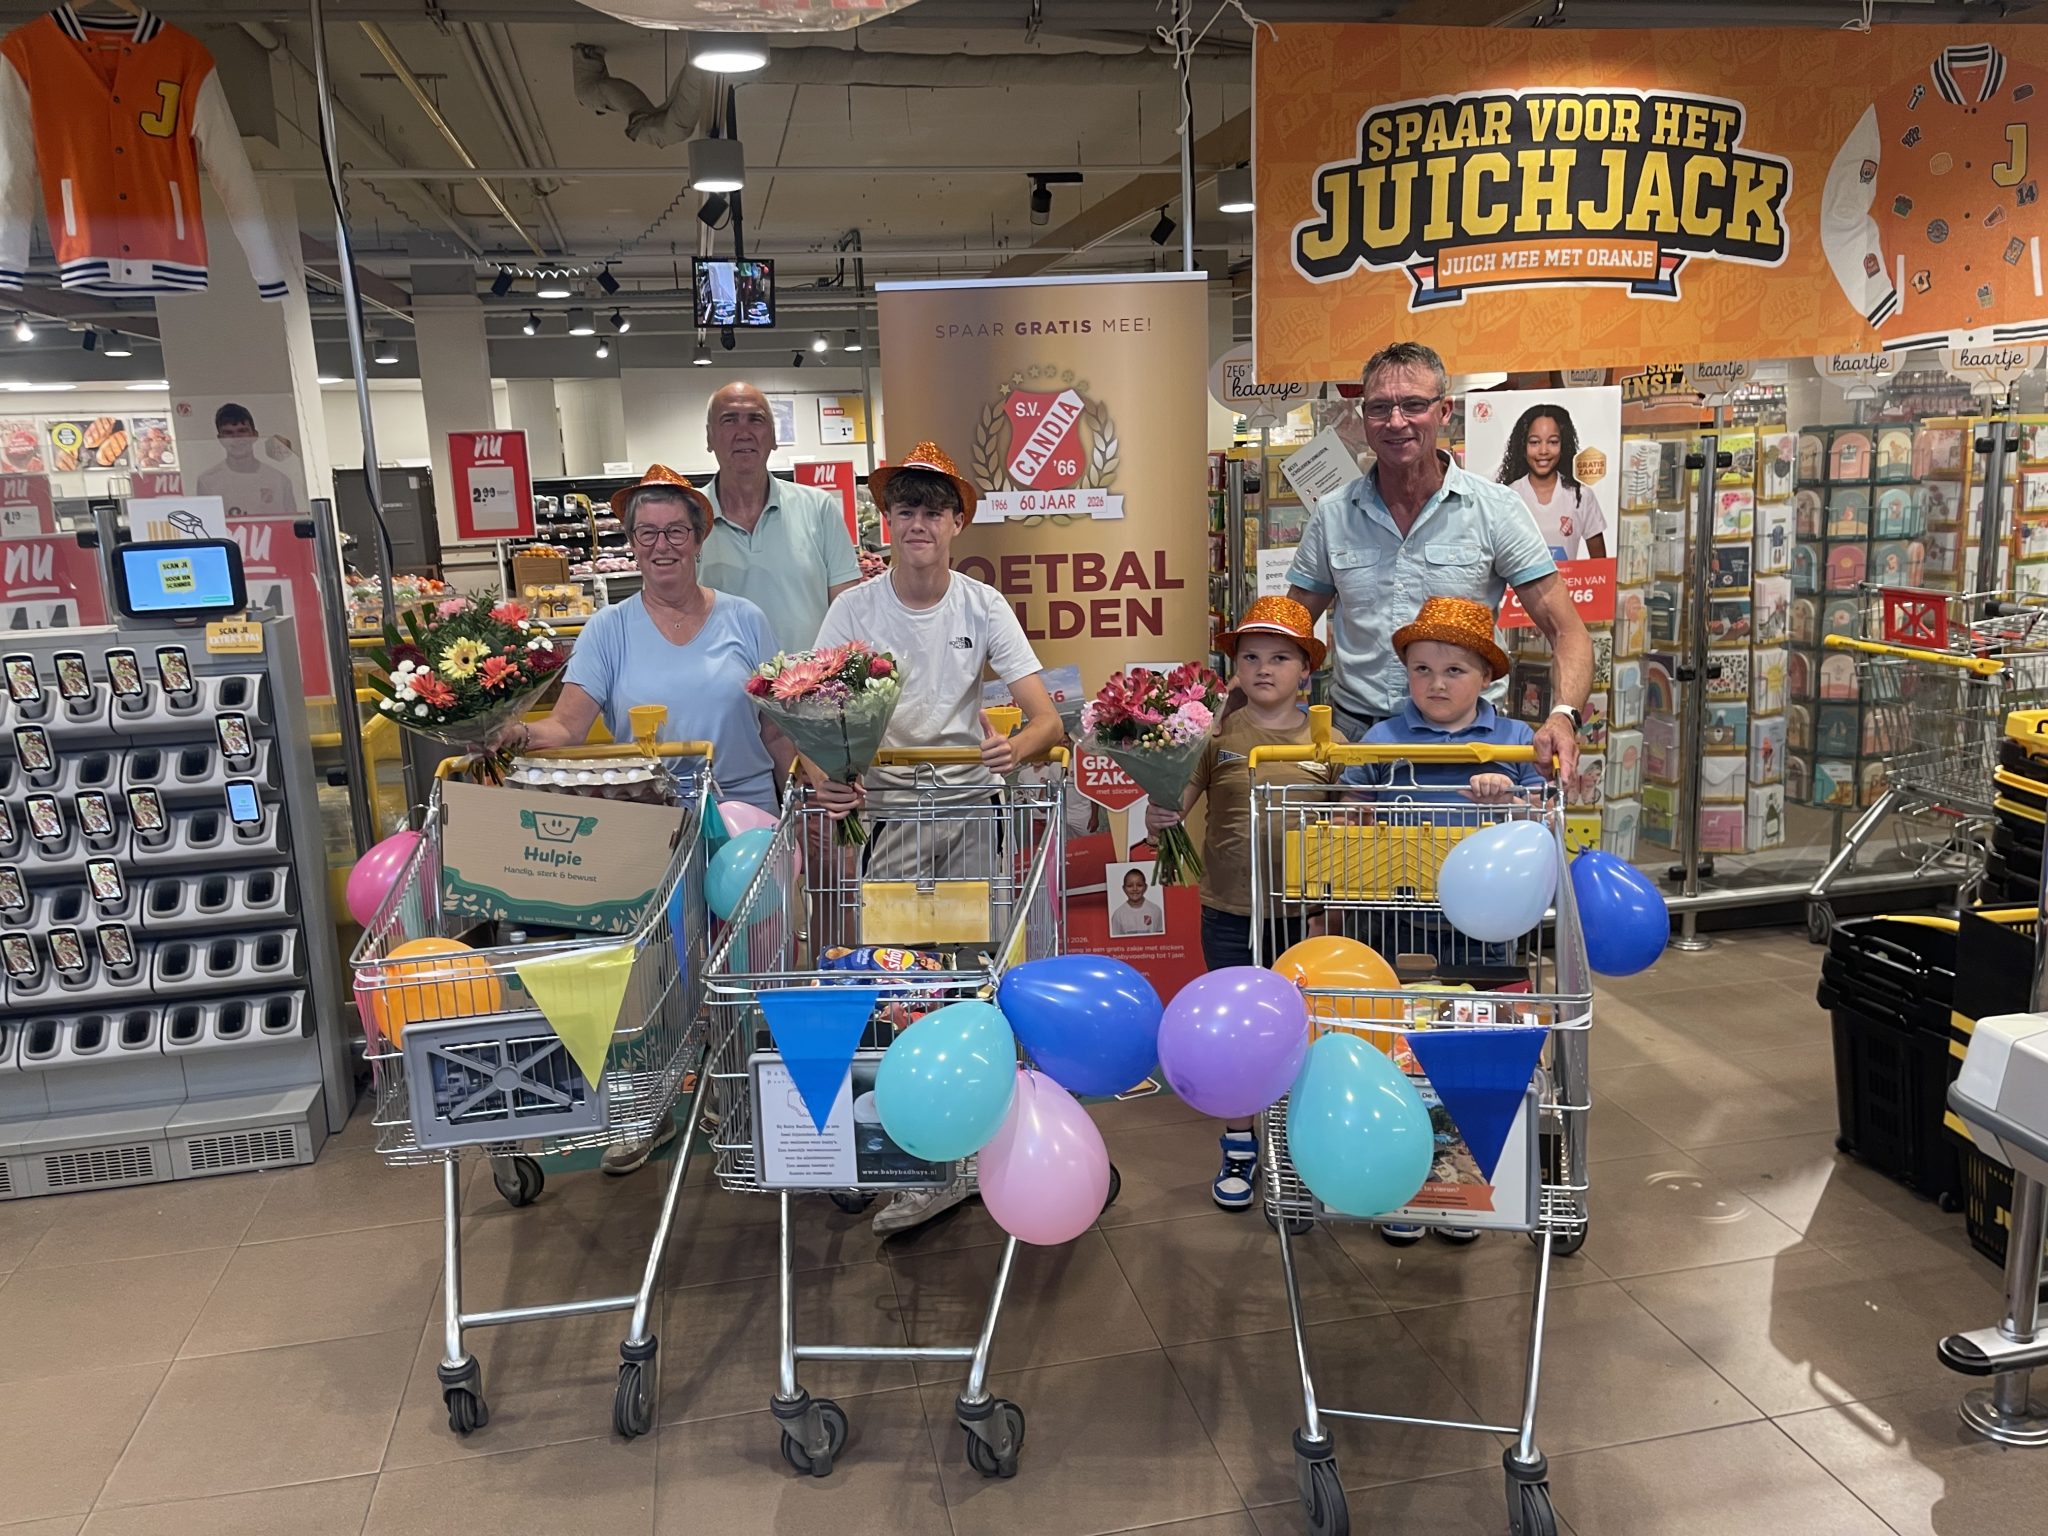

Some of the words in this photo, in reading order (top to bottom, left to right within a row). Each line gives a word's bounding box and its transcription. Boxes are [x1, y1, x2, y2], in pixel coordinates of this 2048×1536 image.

[139, 80, 182, 138] J
[1368, 101, 1512, 161] SPAAR
[1526, 98, 1640, 142] VOOR
[1651, 101, 1736, 152] HET
[1992, 123, 2027, 187] J
[2017, 184, 2036, 205] 14
[1302, 149, 1784, 261] JUICHJACK
[1441, 253, 1496, 276] JUICH
[1501, 250, 1538, 270] MEE
[1543, 248, 1582, 267] MET
[1586, 248, 1654, 268] ORANJE
[935, 322, 1004, 339] SPAAR
[1014, 319, 1092, 336] GRATIS
[1102, 317, 1152, 333] MEE!
[1647, 363, 1683, 374] SNAC
[1832, 354, 1889, 374] kaartje
[1960, 348, 2024, 371] kaartje
[1226, 365, 1245, 378] ZEG
[1698, 362, 1745, 381] kaartje
[1015, 402, 1041, 417] S.V.
[474, 434, 503, 458] nu
[1015, 400, 1080, 477] CANDIA
[814, 464, 836, 484] nu
[1053, 459, 1077, 476] '66
[1576, 461, 1605, 470] GRATIS
[1577, 468, 1603, 477] ZAKJE
[4, 479, 28, 498] nu
[154, 474, 180, 493] nu
[1019, 495, 1035, 511] 60
[1039, 494, 1076, 511] JAAR
[226, 525, 272, 562] nu
[4, 543, 54, 585] nu
[949, 550, 1185, 595] OETBAL
[1584, 575, 1606, 585] VAN
[1569, 589, 1594, 603] '66
[1015, 597, 1163, 640] LDEN
[219, 627, 237, 635] SCAN
[240, 626, 248, 634] JE
[1082, 755, 1122, 770] GRA
[1086, 771, 1135, 786] ZAK
[524, 846, 582, 867] Hulpie
[504, 865, 534, 876] Handig,
[537, 870, 557, 878] sterk
[567, 872, 598, 883] bewust
